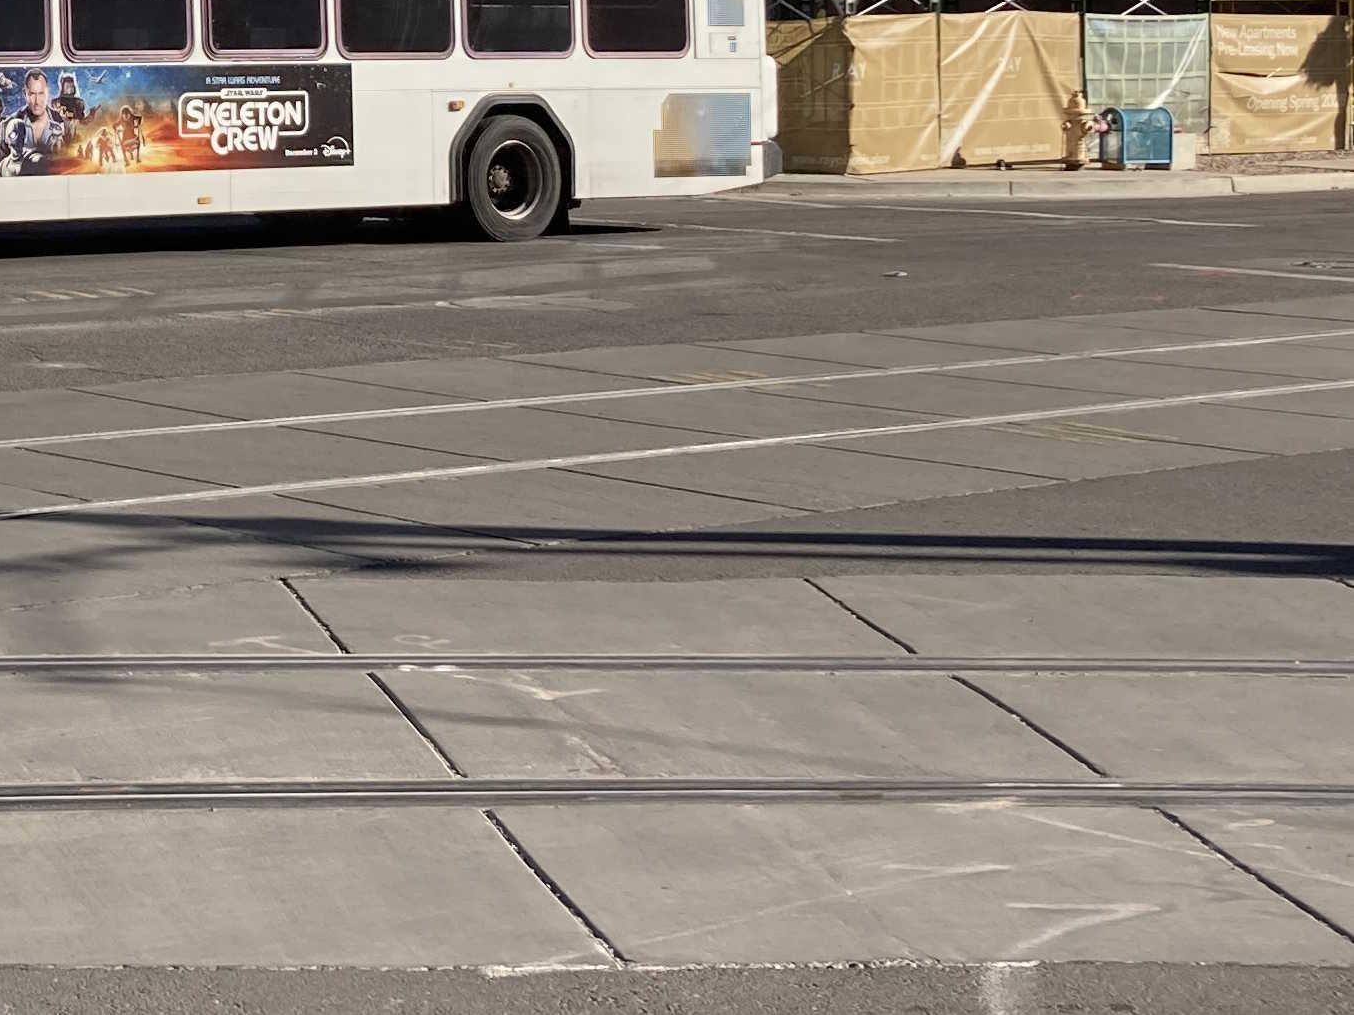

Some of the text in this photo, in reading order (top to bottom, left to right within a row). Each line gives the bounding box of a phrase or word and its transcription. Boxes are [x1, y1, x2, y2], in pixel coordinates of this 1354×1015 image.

[1215, 25, 1297, 41] New Apartments
[186, 99, 302, 129] SKELETON
[1247, 97, 1288, 113] Opening
[1289, 94, 1320, 112] Spring
[211, 125, 279, 155] CREW
